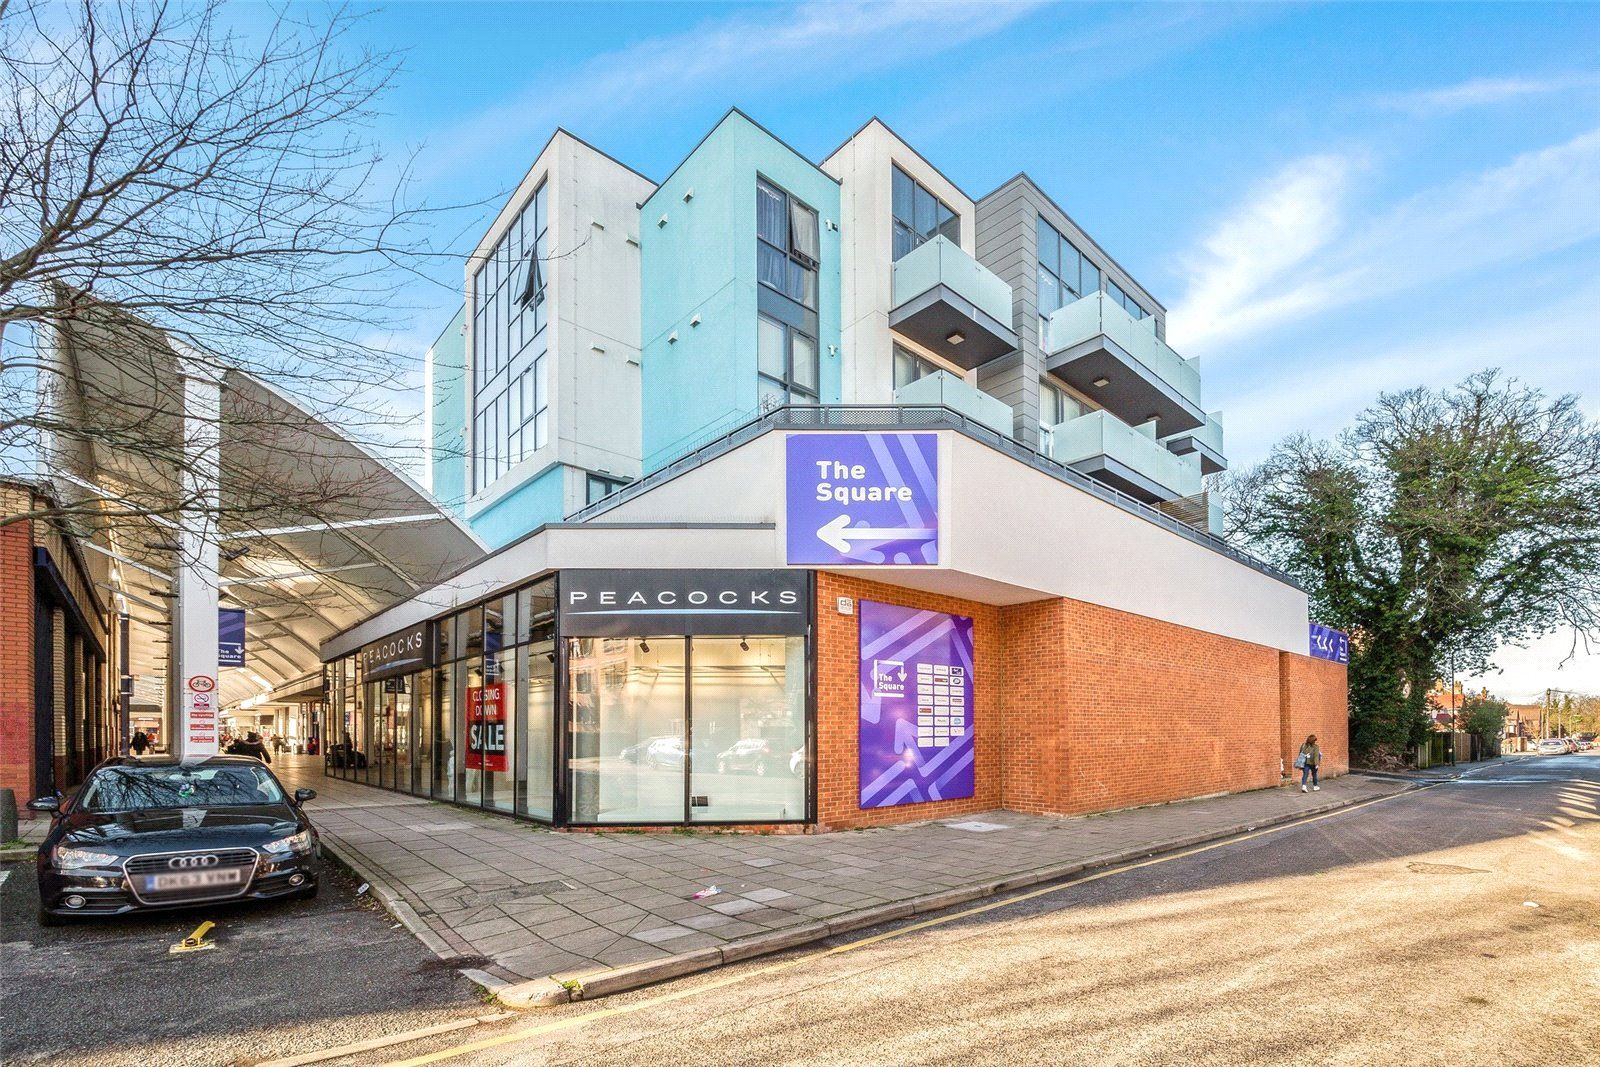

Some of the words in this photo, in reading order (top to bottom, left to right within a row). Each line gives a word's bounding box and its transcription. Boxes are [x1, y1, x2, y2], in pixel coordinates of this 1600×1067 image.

[816, 460, 866, 480] The
[816, 482, 913, 506] Square
[569, 591, 798, 605] PEACOCKS
[363, 631, 423, 664] PEACOCKS
[878, 673, 893, 682] The
[878, 682, 905, 691] Square
[470, 724, 505, 751] SALE
